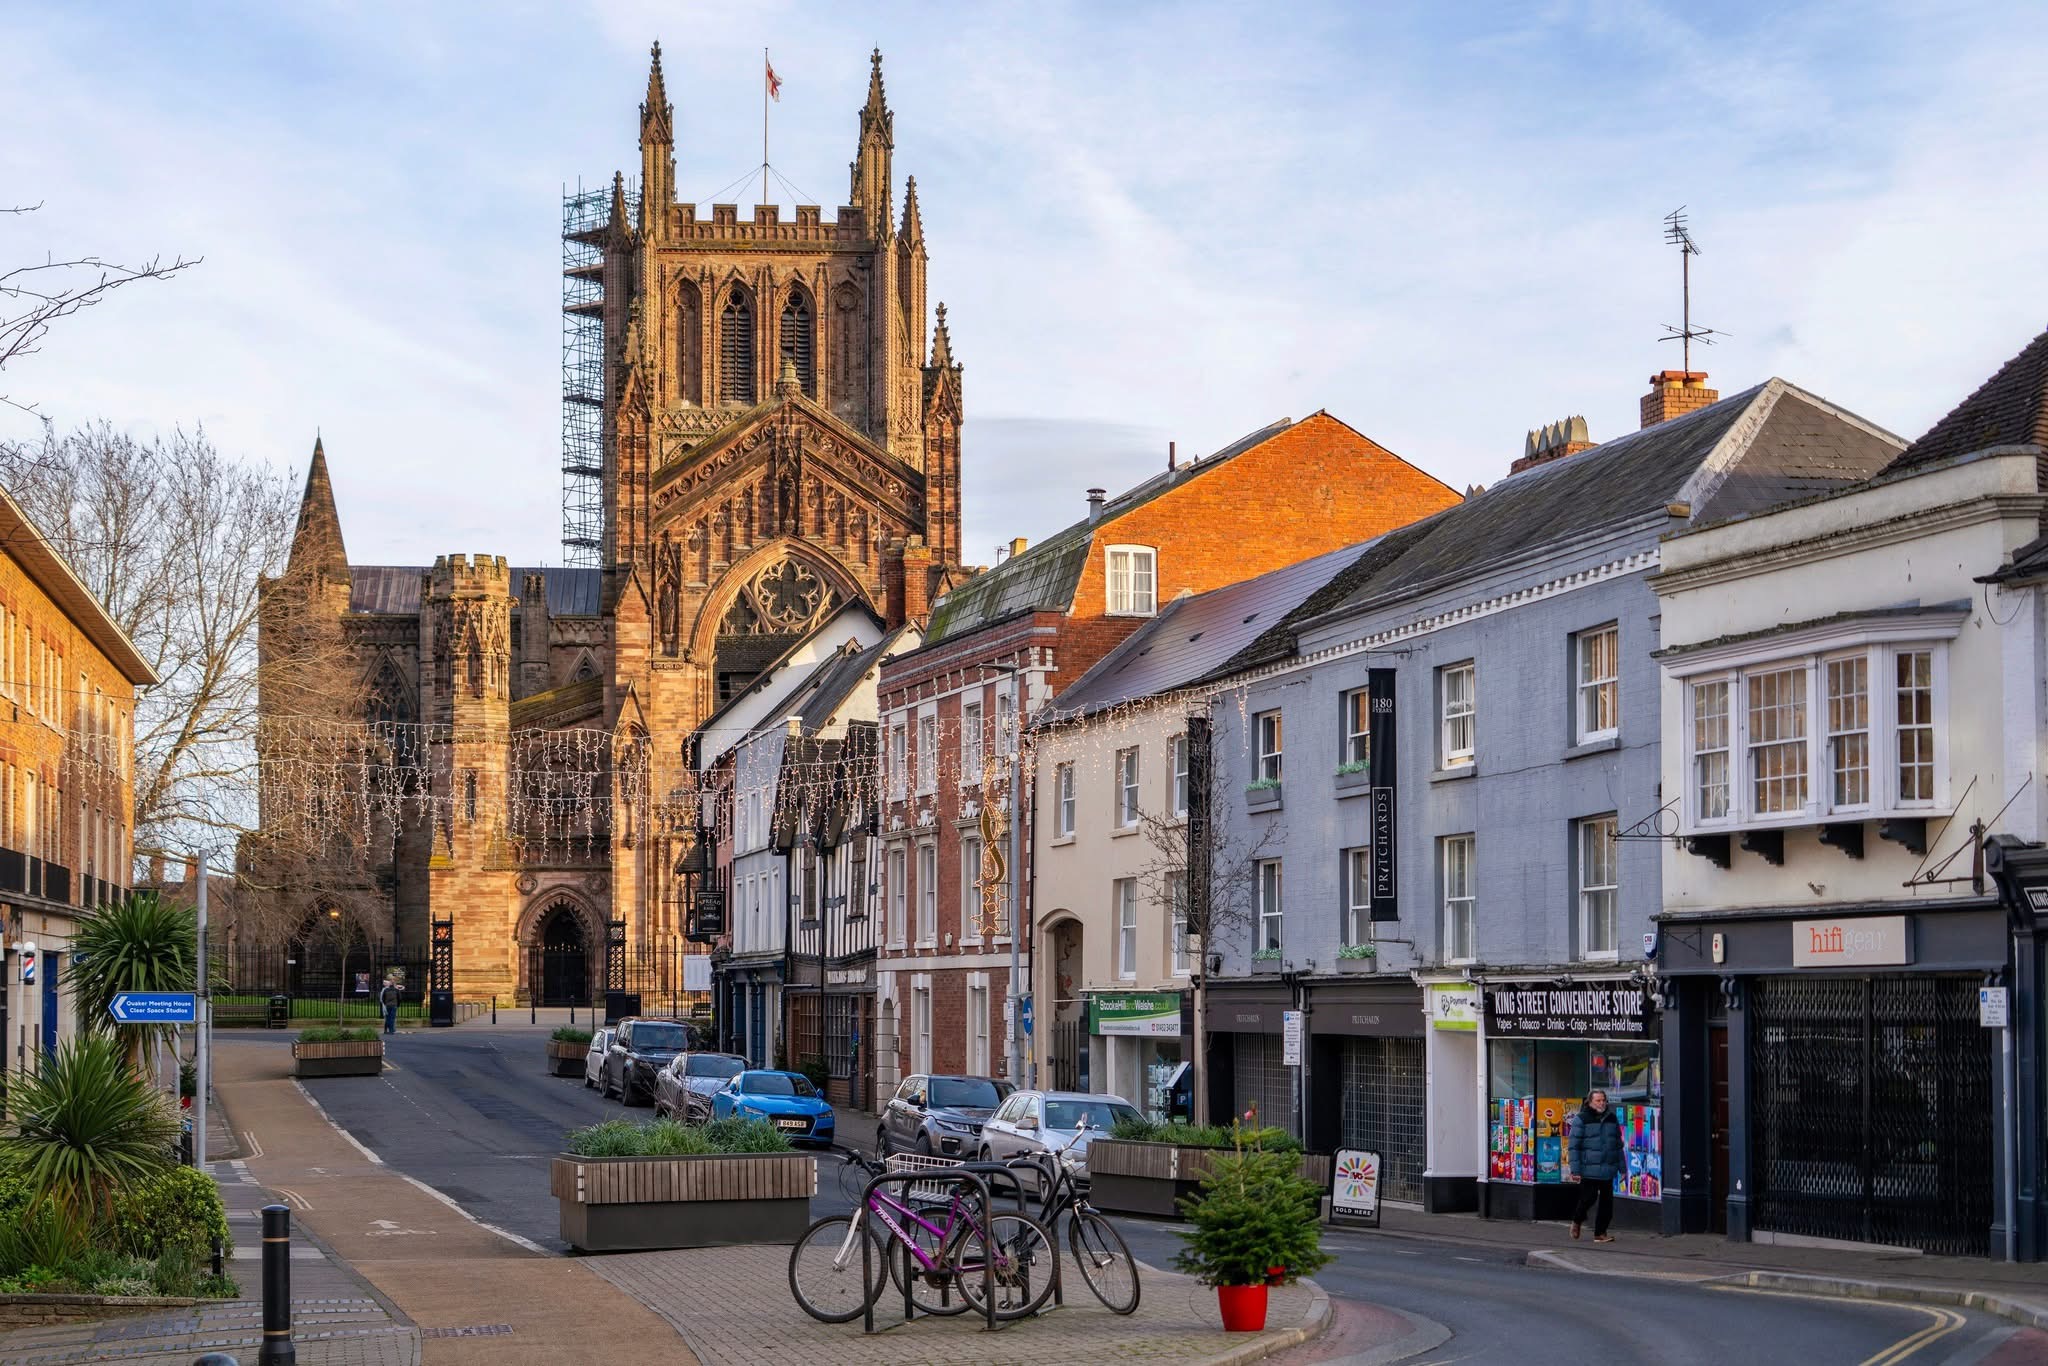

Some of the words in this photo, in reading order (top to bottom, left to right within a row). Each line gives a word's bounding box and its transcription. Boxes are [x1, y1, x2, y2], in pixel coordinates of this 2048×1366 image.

[1375, 698, 1393, 708] 180
[1450, 996, 1468, 1006] Payment
[1495, 991, 1515, 1014] KING
[1517, 991, 1547, 1014] STREET
[1549, 991, 1611, 1015] CONVENIENCE
[1612, 991, 1643, 1015] STORE
[1496, 1017, 1512, 1032] Vapes
[1518, 1017, 1541, 1030] Tobacco
[1547, 1017, 1565, 1030] Drinks
[1570, 1017, 1587, 1034] Crisps
[1593, 1018, 1611, 1031] House
[1611, 1018, 1626, 1031] Hold
[1626, 1018, 1643, 1032] Items
[1354, 1208, 1371, 1216] HERE
